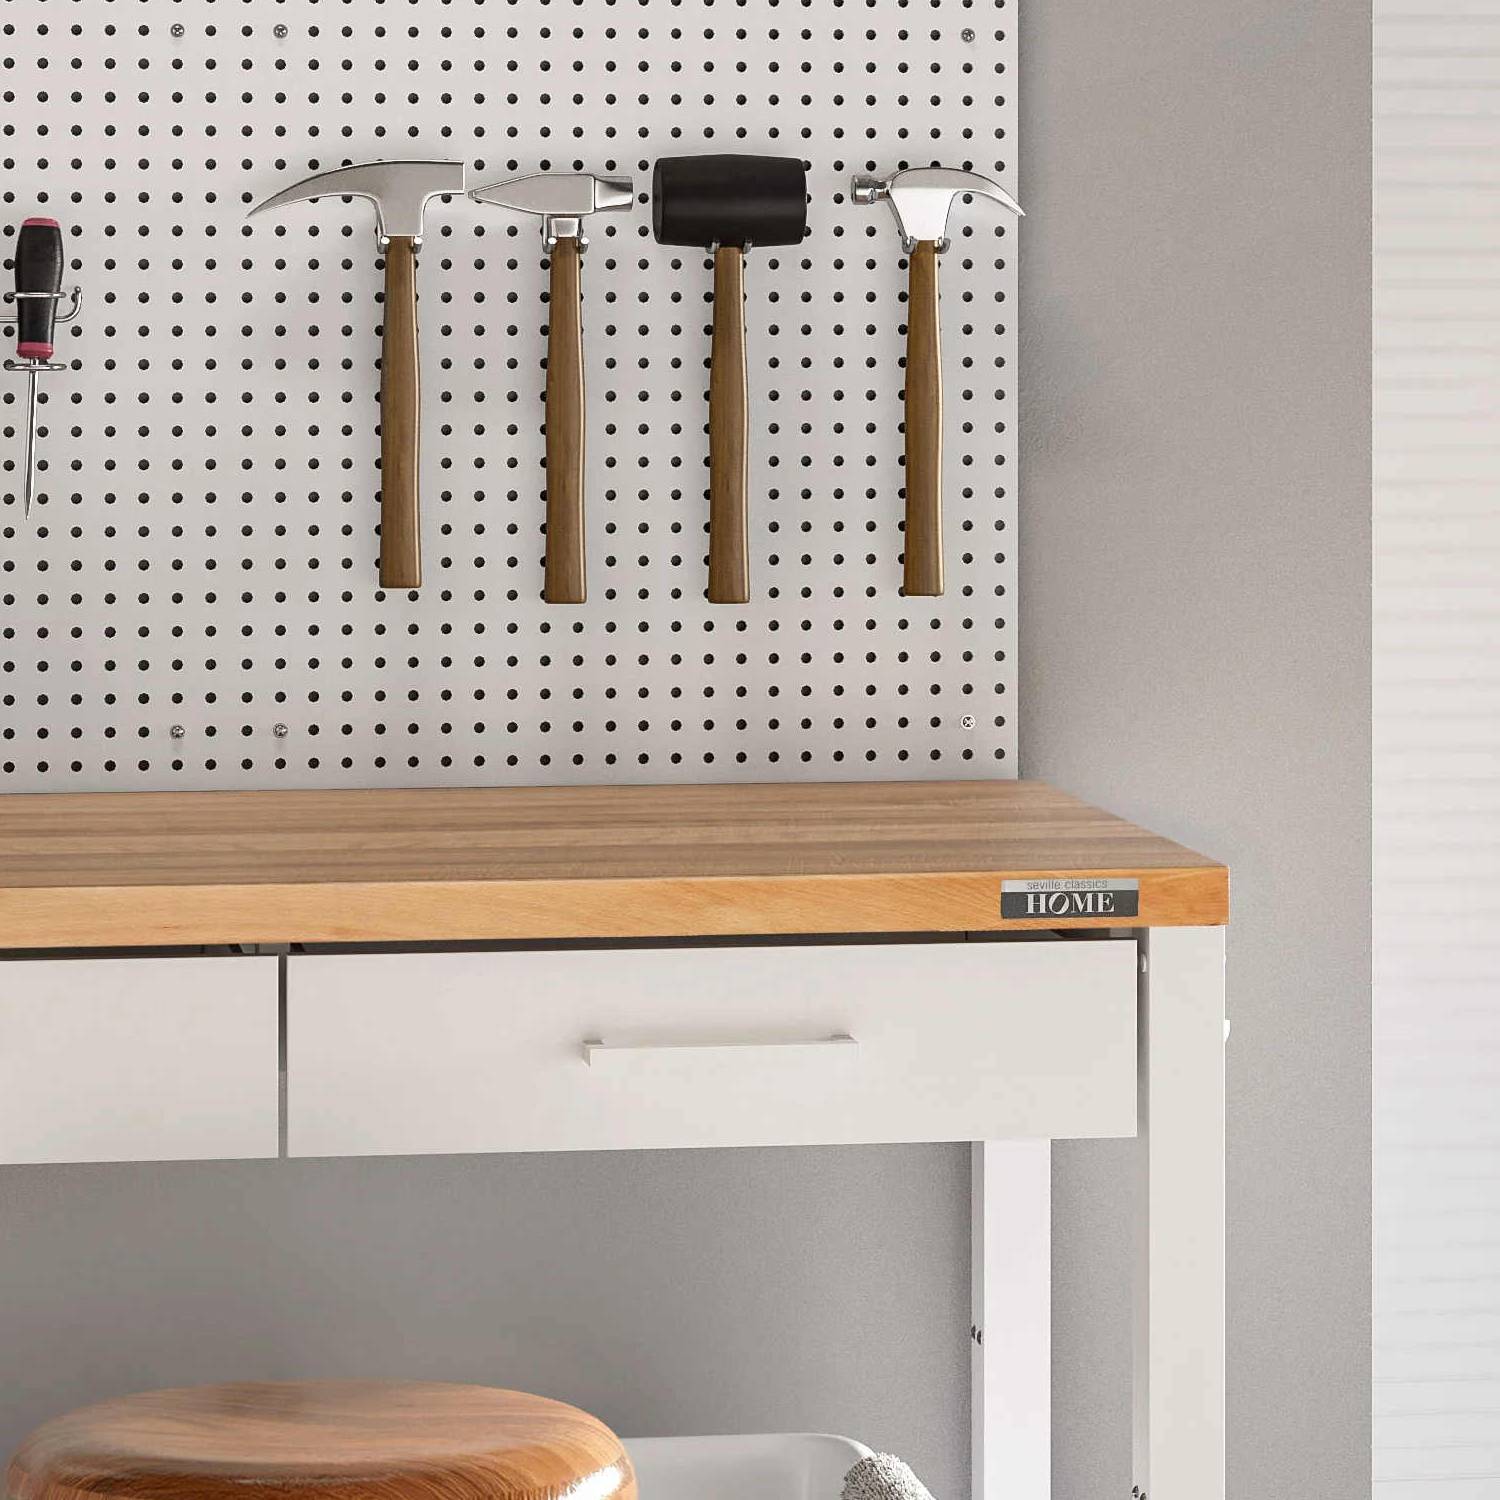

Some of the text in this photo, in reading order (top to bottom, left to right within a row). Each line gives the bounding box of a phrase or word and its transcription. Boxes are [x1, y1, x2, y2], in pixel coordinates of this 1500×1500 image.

[1027, 879, 1108, 890] seville classics
[1026, 892, 1115, 915] HOME
